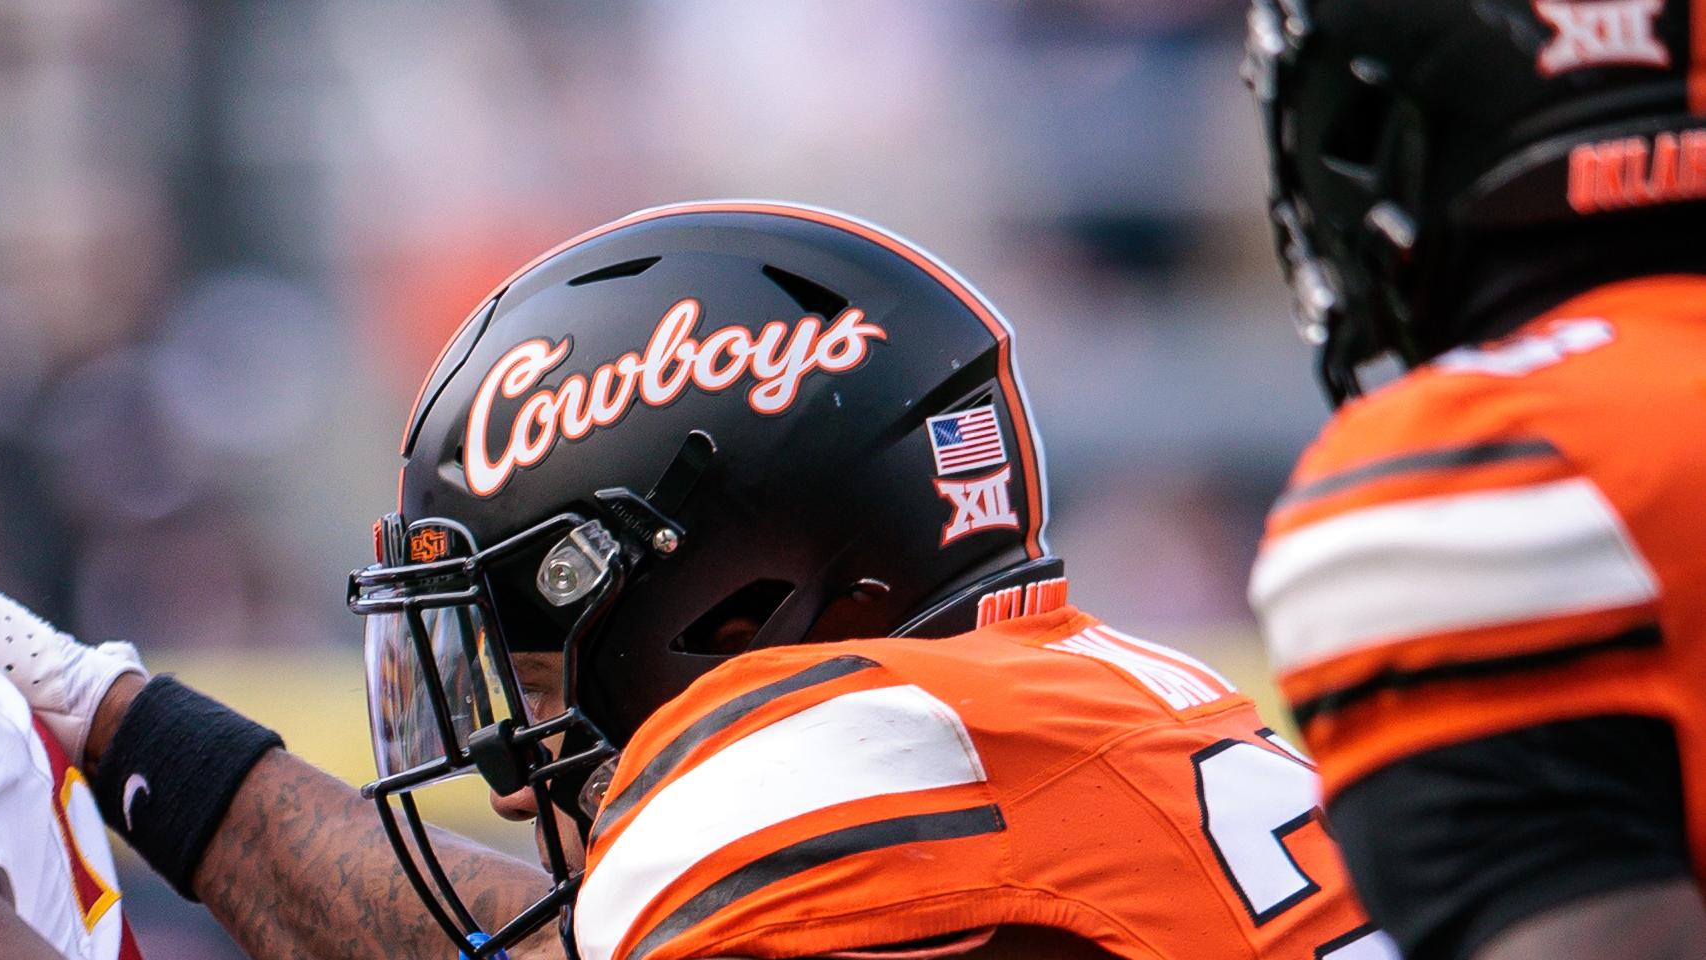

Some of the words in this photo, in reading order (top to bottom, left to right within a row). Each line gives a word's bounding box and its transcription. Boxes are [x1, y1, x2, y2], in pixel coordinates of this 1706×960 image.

[462, 298, 887, 497] Cowboys
[410, 527, 448, 562] OSU
[932, 462, 1020, 549] XII
